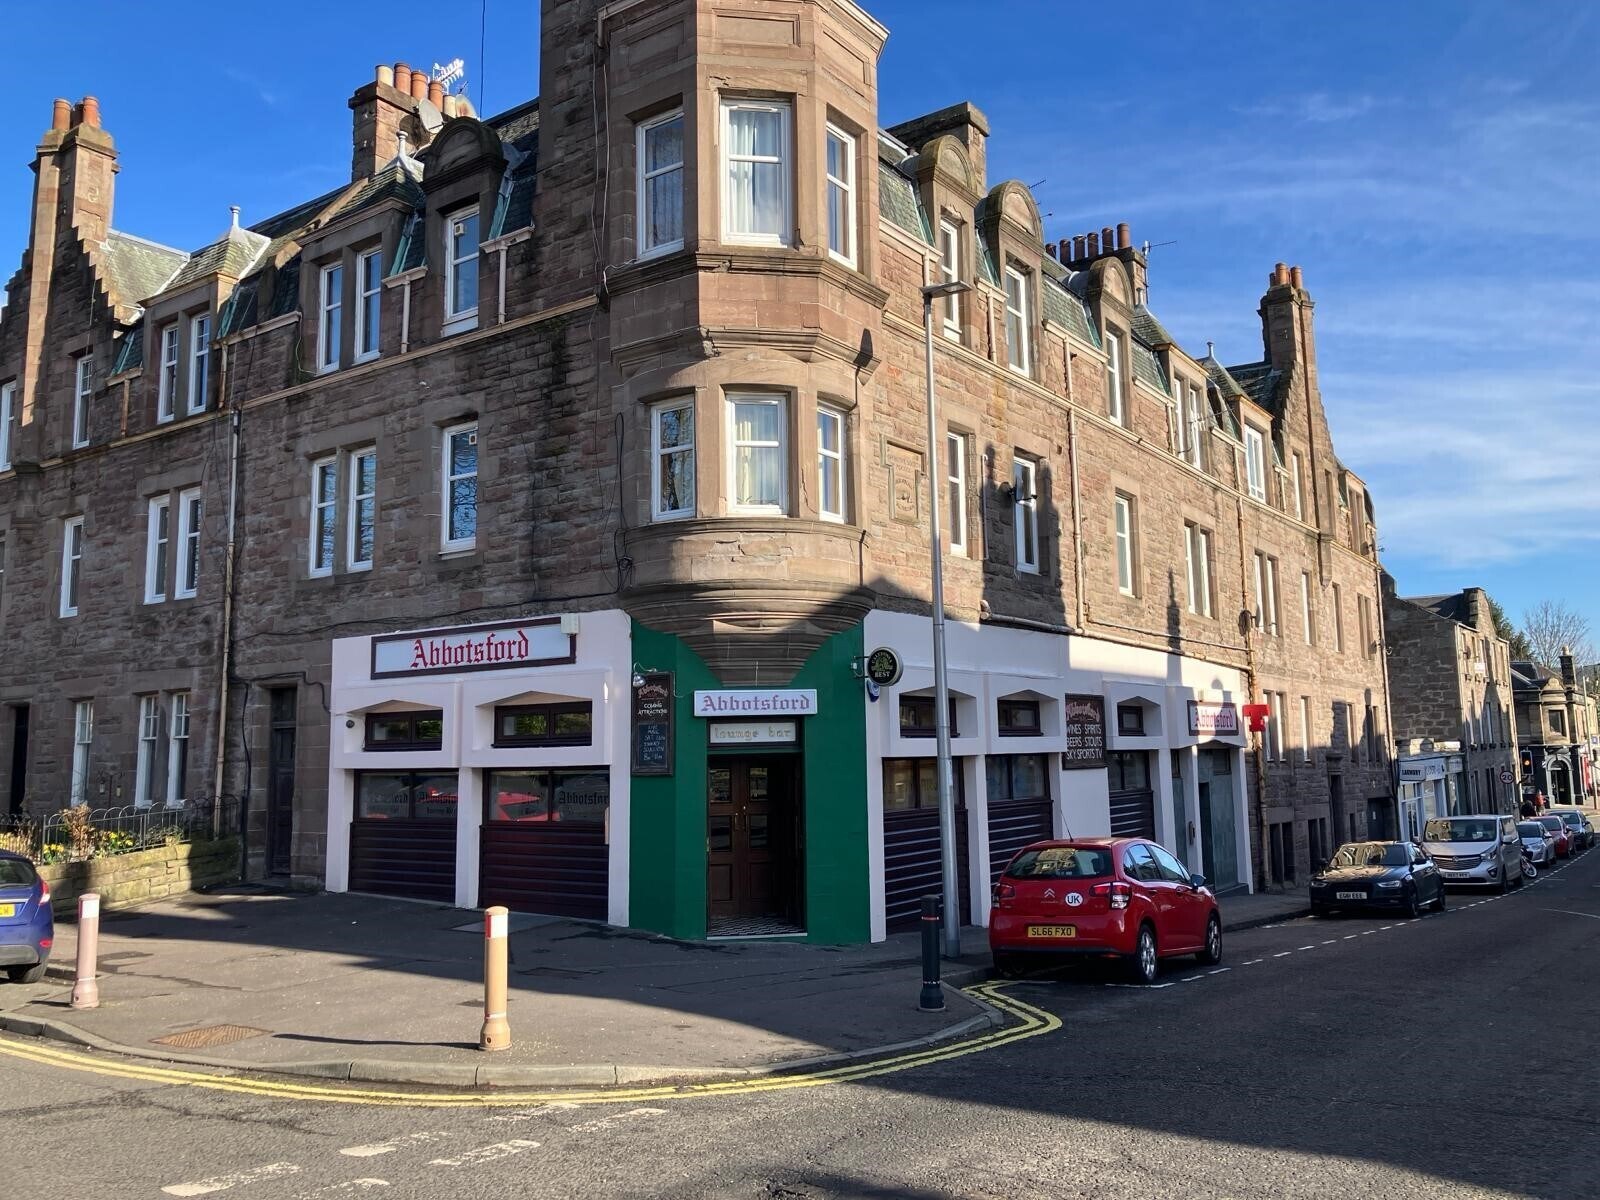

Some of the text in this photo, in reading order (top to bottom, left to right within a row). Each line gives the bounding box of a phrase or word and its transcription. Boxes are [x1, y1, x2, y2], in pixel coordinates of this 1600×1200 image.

[411, 629, 529, 668] Abbotsford
[701, 694, 810, 712] Abbotsford
[1195, 707, 1233, 728] Abbotsford
[715, 726, 791, 741] lounge bar
[1085, 724, 1102, 734] SPIRITS
[1067, 736, 1103, 747] BEERS STOUTS
[1066, 748, 1103, 760] SKY SPORTS TV
[559, 790, 610, 805] Abbotsfor
[1067, 896, 1080, 904] UK
[1031, 927, 1072, 936] SL66 FXO
